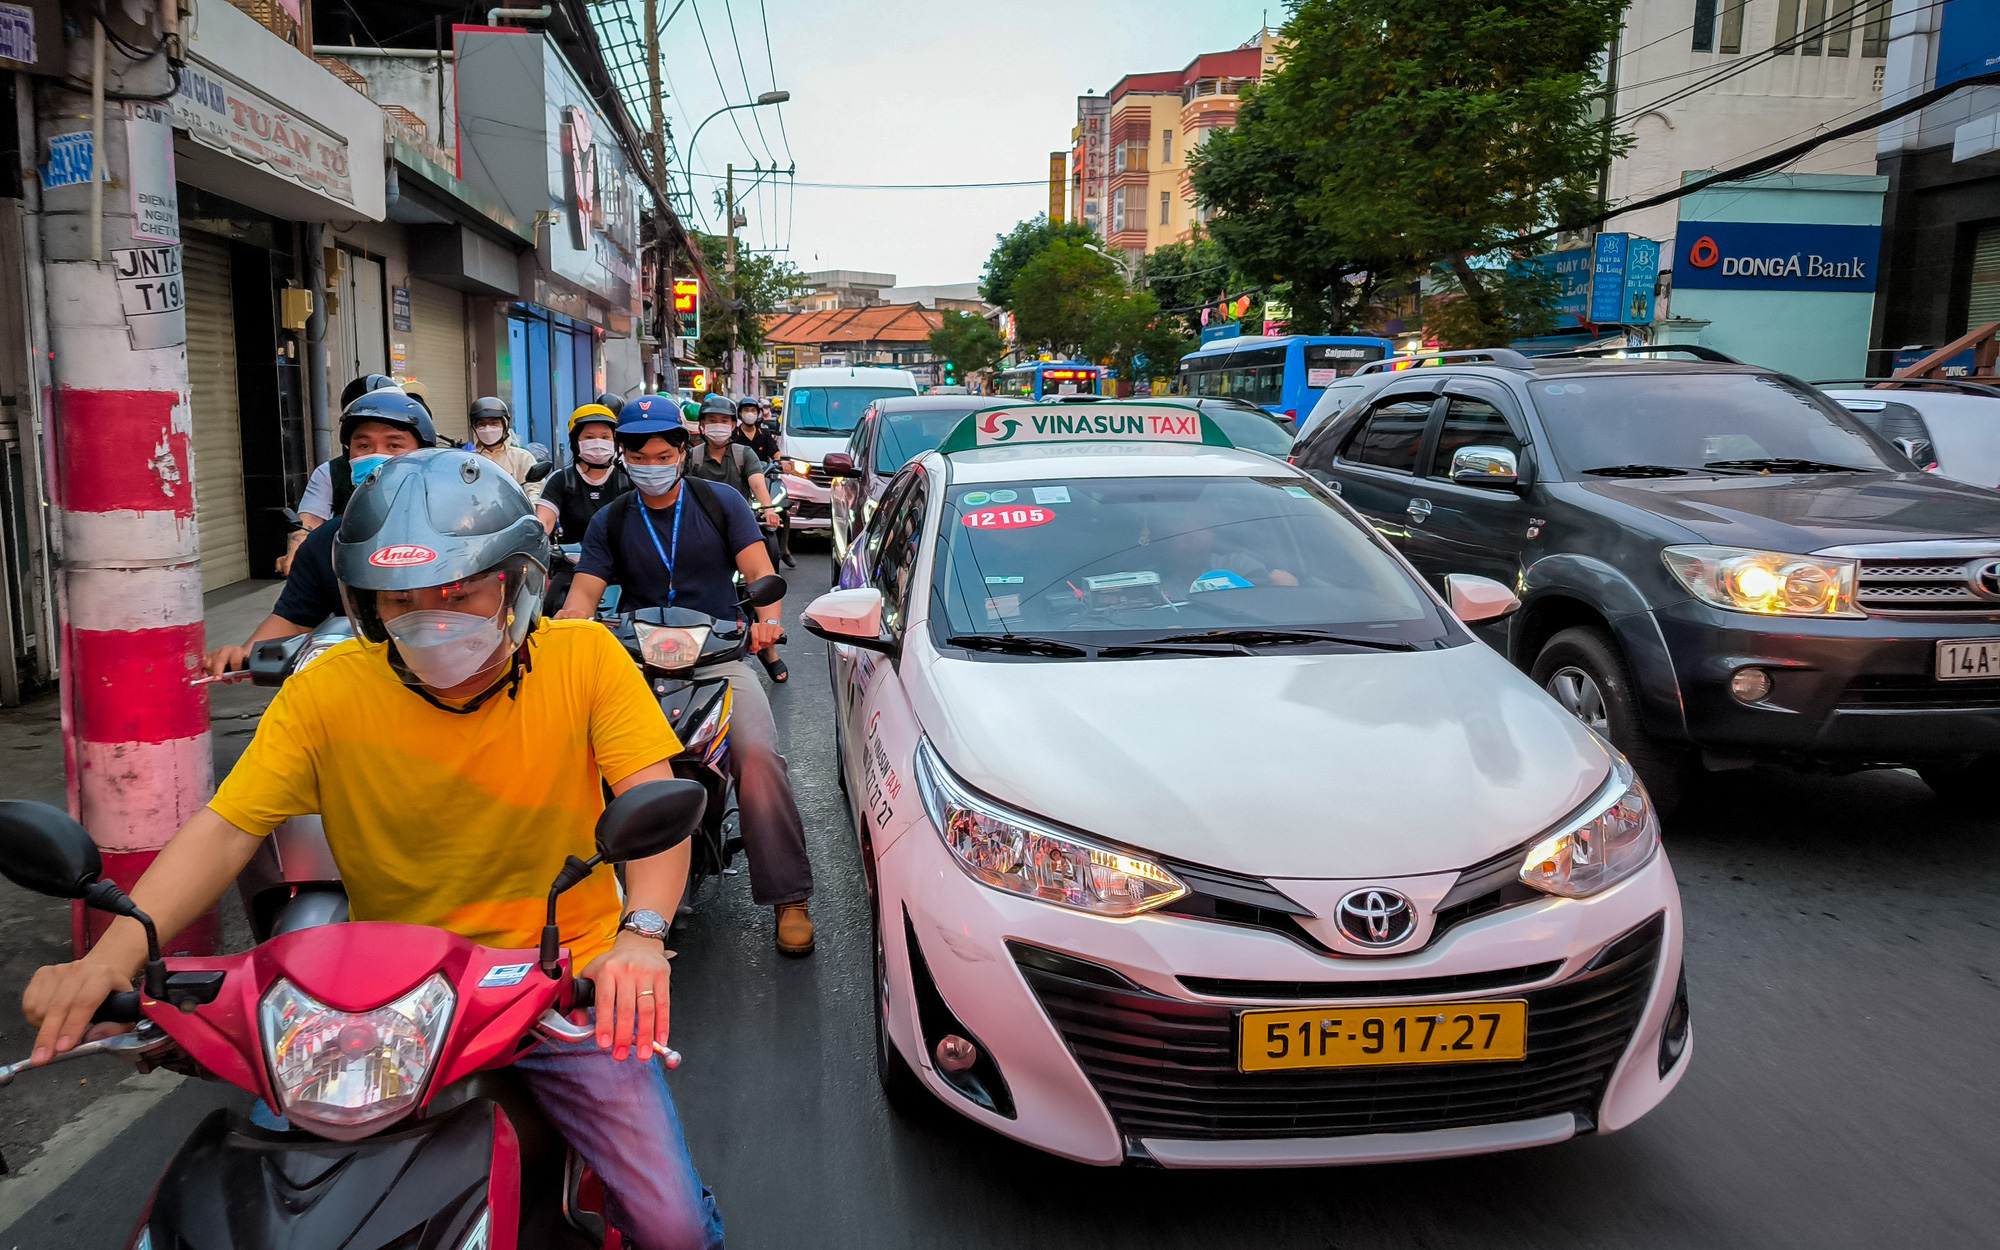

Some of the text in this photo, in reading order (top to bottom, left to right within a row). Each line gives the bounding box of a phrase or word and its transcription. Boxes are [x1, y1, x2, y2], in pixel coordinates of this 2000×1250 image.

[1088, 118, 1099, 198] HOTEL
[1807, 255, 1866, 278] Bank
[1031, 415, 1196, 435] VINASUN TAXI
[967, 509, 1045, 527] 12105
[374, 548, 433, 561] Andes
[885, 769, 902, 800] TAXI
[877, 800, 894, 830] 27
[1266, 1013, 1501, 1059] 51F-917.27
